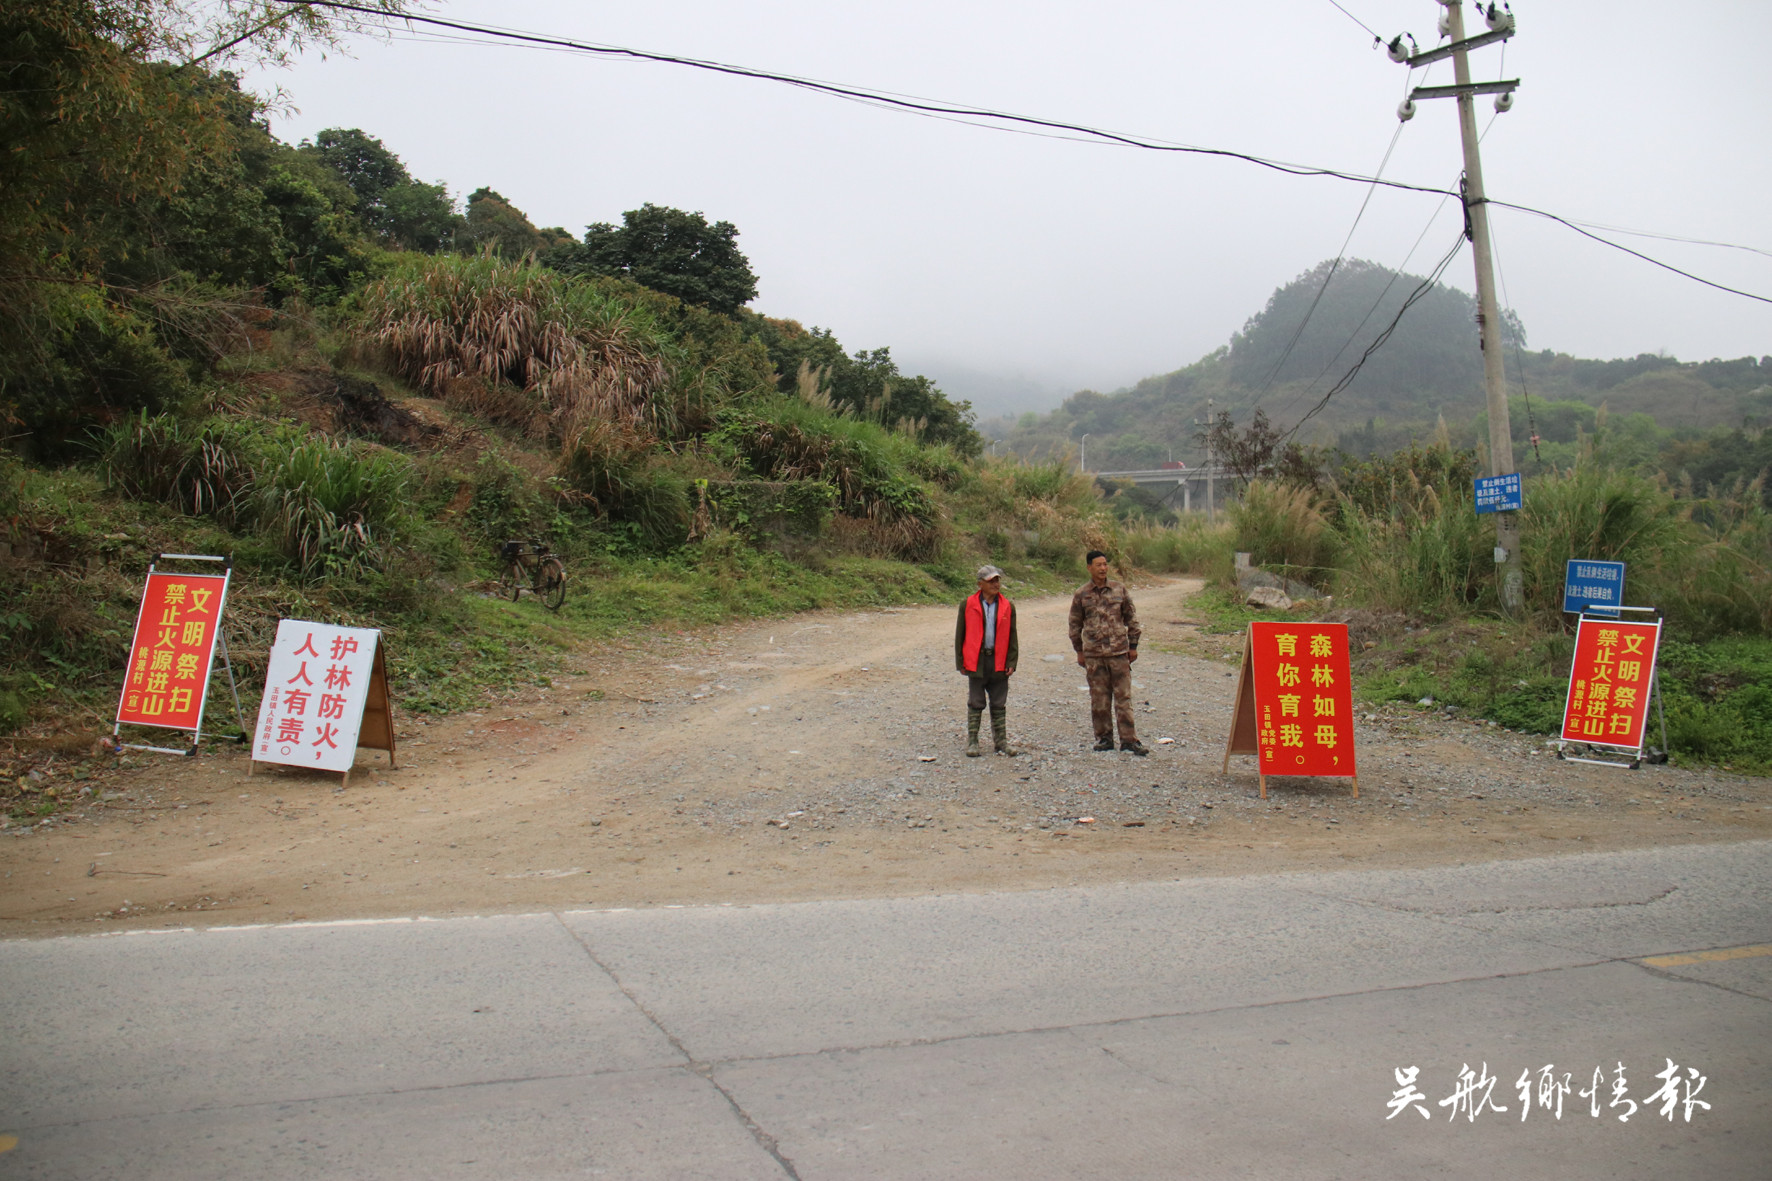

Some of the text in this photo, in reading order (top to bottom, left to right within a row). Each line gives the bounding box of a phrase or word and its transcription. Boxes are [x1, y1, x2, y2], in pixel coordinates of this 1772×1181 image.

[125, 646, 151, 713] 桃源村（宣）
[141, 583, 187, 716] 禁止火源进山
[168, 587, 213, 714] 文明祭扫
[275, 632, 319, 756] 人人有责。
[311, 634, 359, 761] 护林防火，
[1275, 633, 1305, 765] 育你育我。
[1309, 633, 1339, 766] 森林如母，
[1567, 679, 1586, 733] 桃源村（宣）
[1583, 629, 1620, 737] 禁止火源进山
[1609, 633, 1646, 735] 文明祭扫
